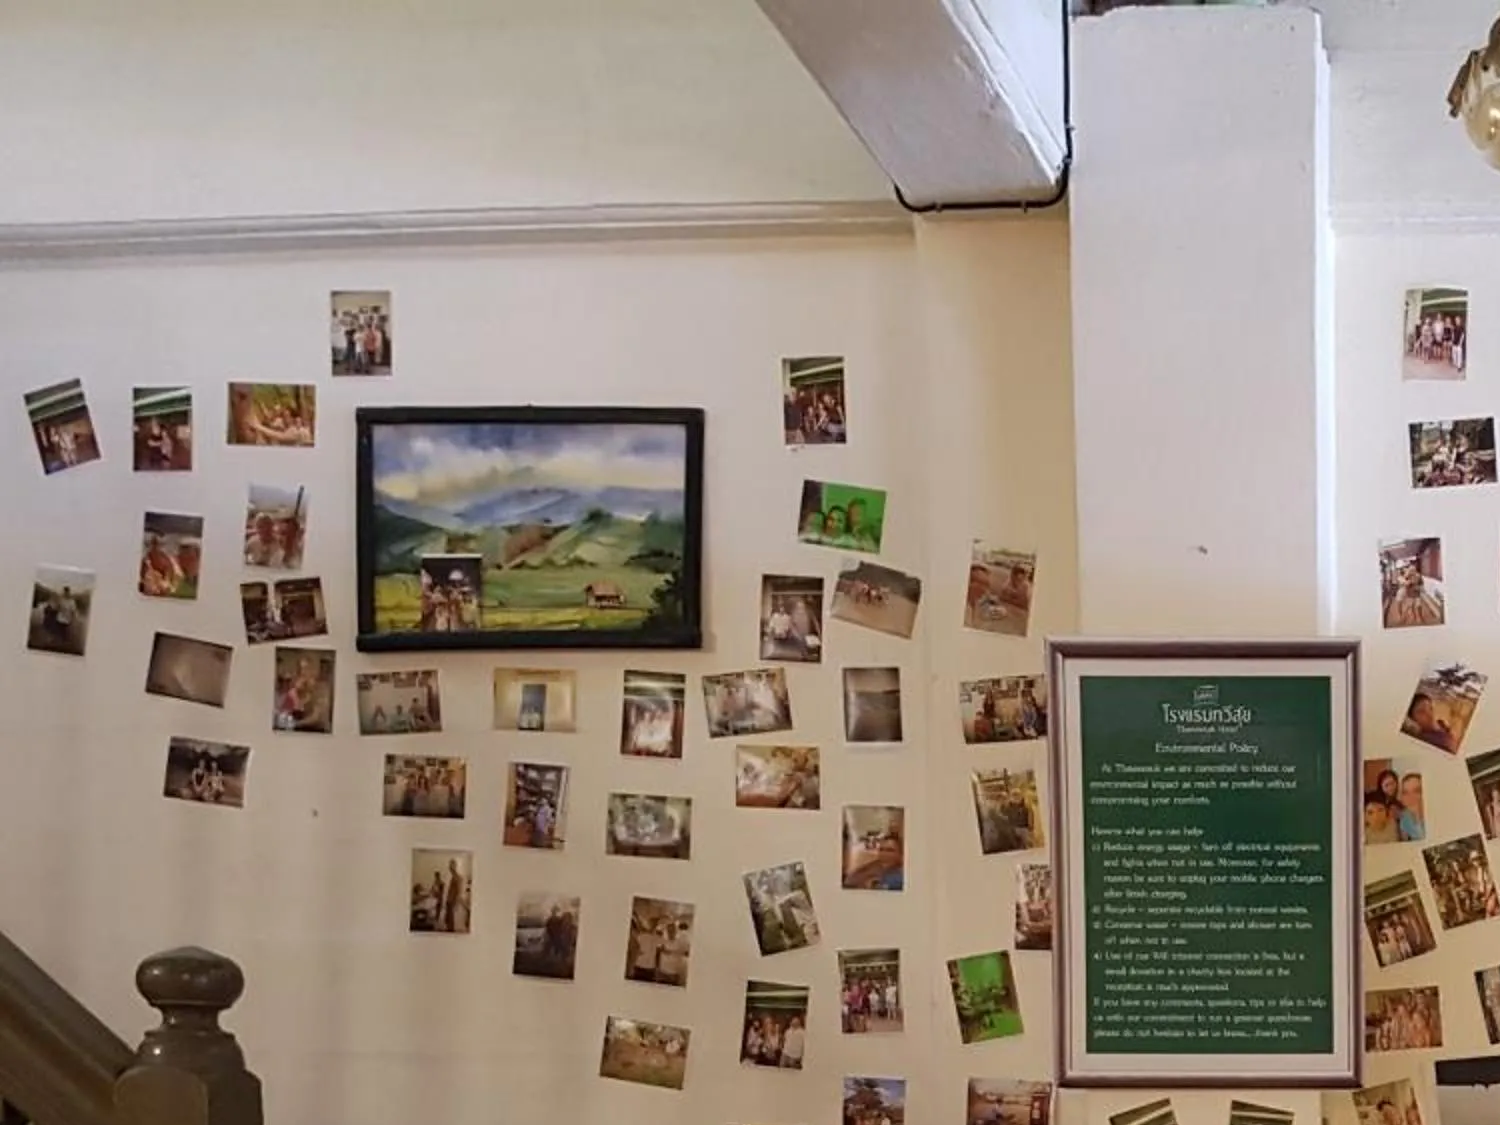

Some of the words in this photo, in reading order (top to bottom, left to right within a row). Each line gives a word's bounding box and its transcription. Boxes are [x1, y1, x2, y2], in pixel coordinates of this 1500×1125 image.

[1154, 742, 1227, 753] Environmental
[1229, 742, 1259, 756] Policy
[1151, 780, 1179, 790] impact
[1193, 780, 1217, 790] much
[1231, 780, 1264, 790] possible
[1266, 780, 1297, 790] without
[1147, 826, 1163, 837] you
[1229, 874, 1257, 884] mobile
[1260, 874, 1287, 884] phone
